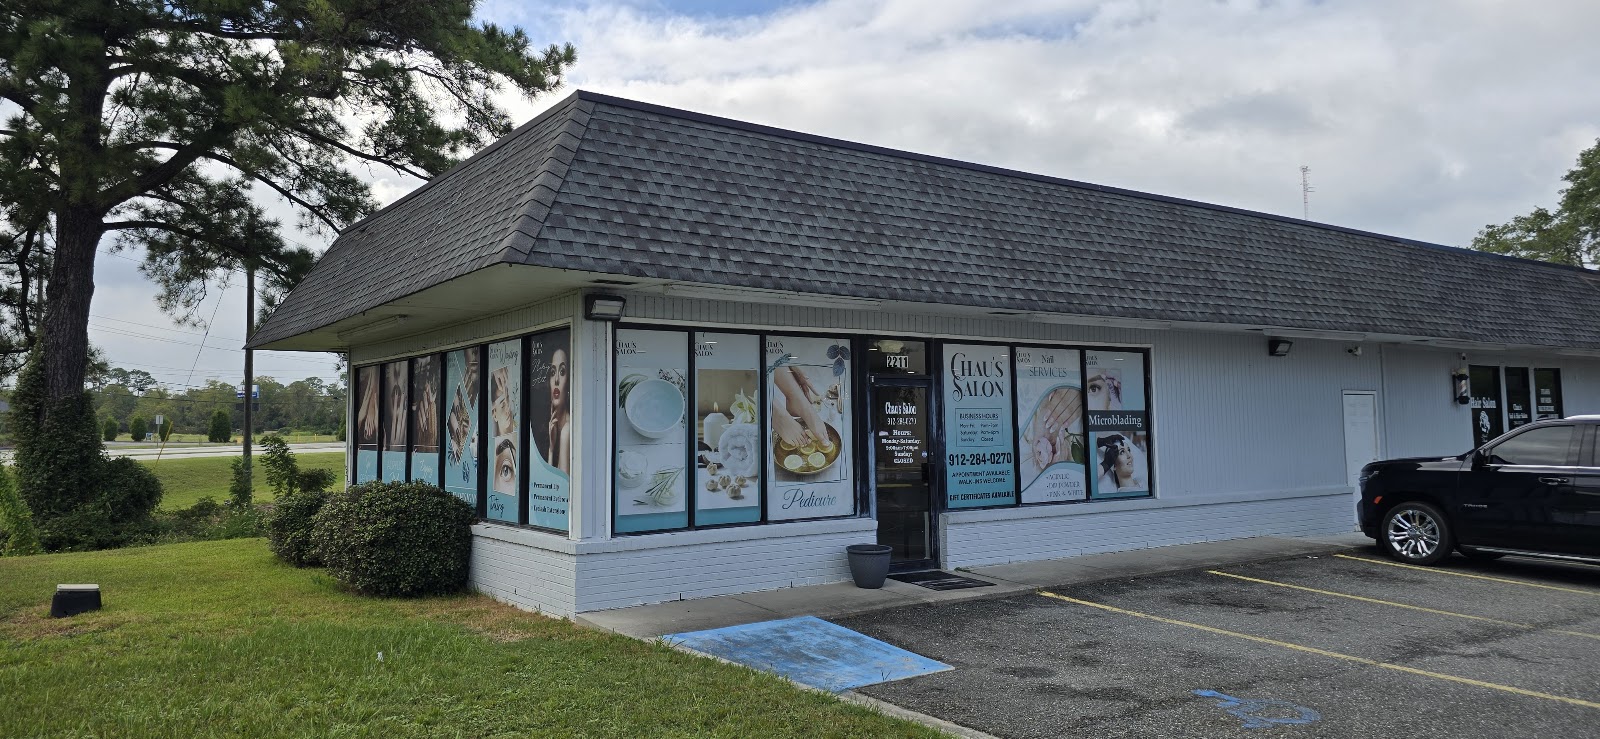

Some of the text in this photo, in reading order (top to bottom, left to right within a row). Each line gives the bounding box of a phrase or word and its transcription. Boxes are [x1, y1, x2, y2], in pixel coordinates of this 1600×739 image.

[886, 356, 908, 368] 2211
[951, 352, 1004, 381] CHAU'S
[1029, 366, 1068, 378] SERVICES
[952, 376, 1004, 402] SALON
[902, 402, 916, 414] Salon
[1470, 396, 1496, 408] Hair Salon
[1088, 414, 1142, 428] Microblading
[948, 452, 1012, 466] 912-284-0270
[782, 488, 837, 509] Pedicure
[960, 492, 991, 501] CERTIFICATES
